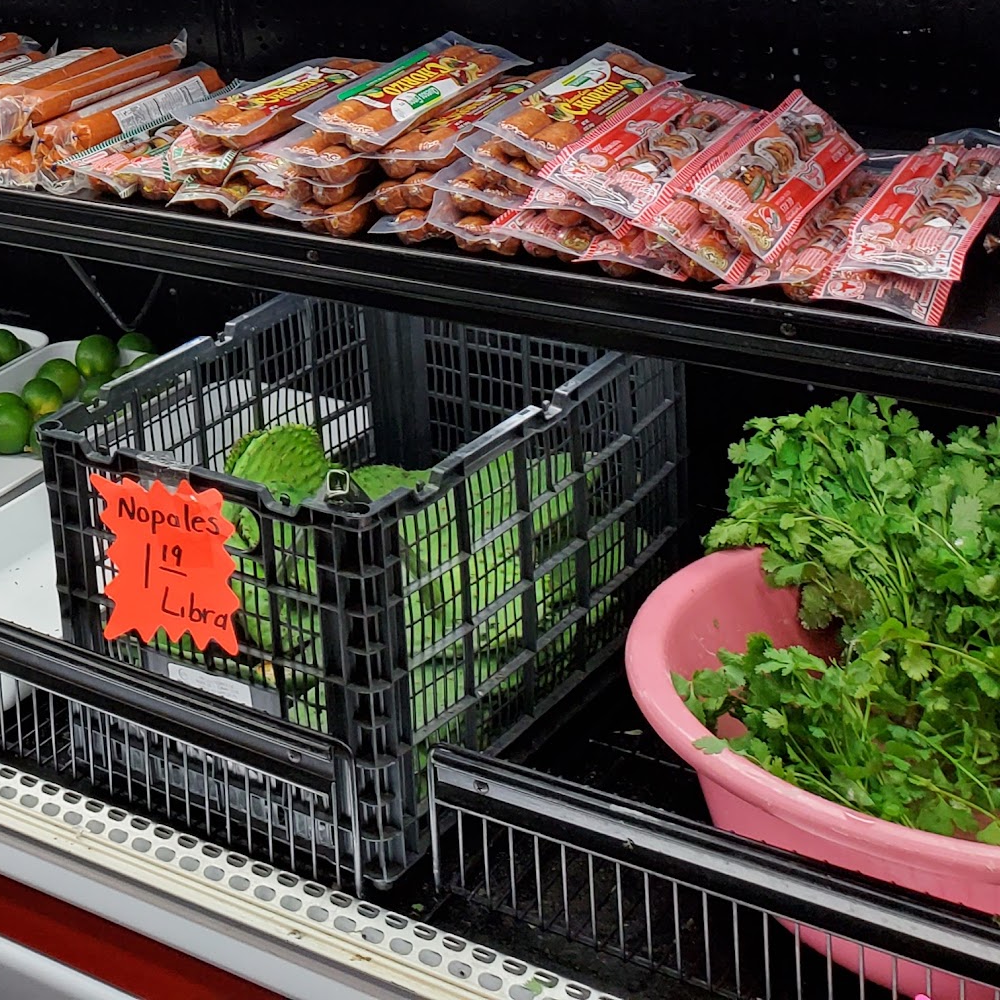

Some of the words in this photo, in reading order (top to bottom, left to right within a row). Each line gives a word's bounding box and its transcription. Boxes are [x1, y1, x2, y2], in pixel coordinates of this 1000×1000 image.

[561, 81, 624, 115] CHORIZO
[118, 496, 220, 535] Nopales
[161, 586, 228, 630] Libra
